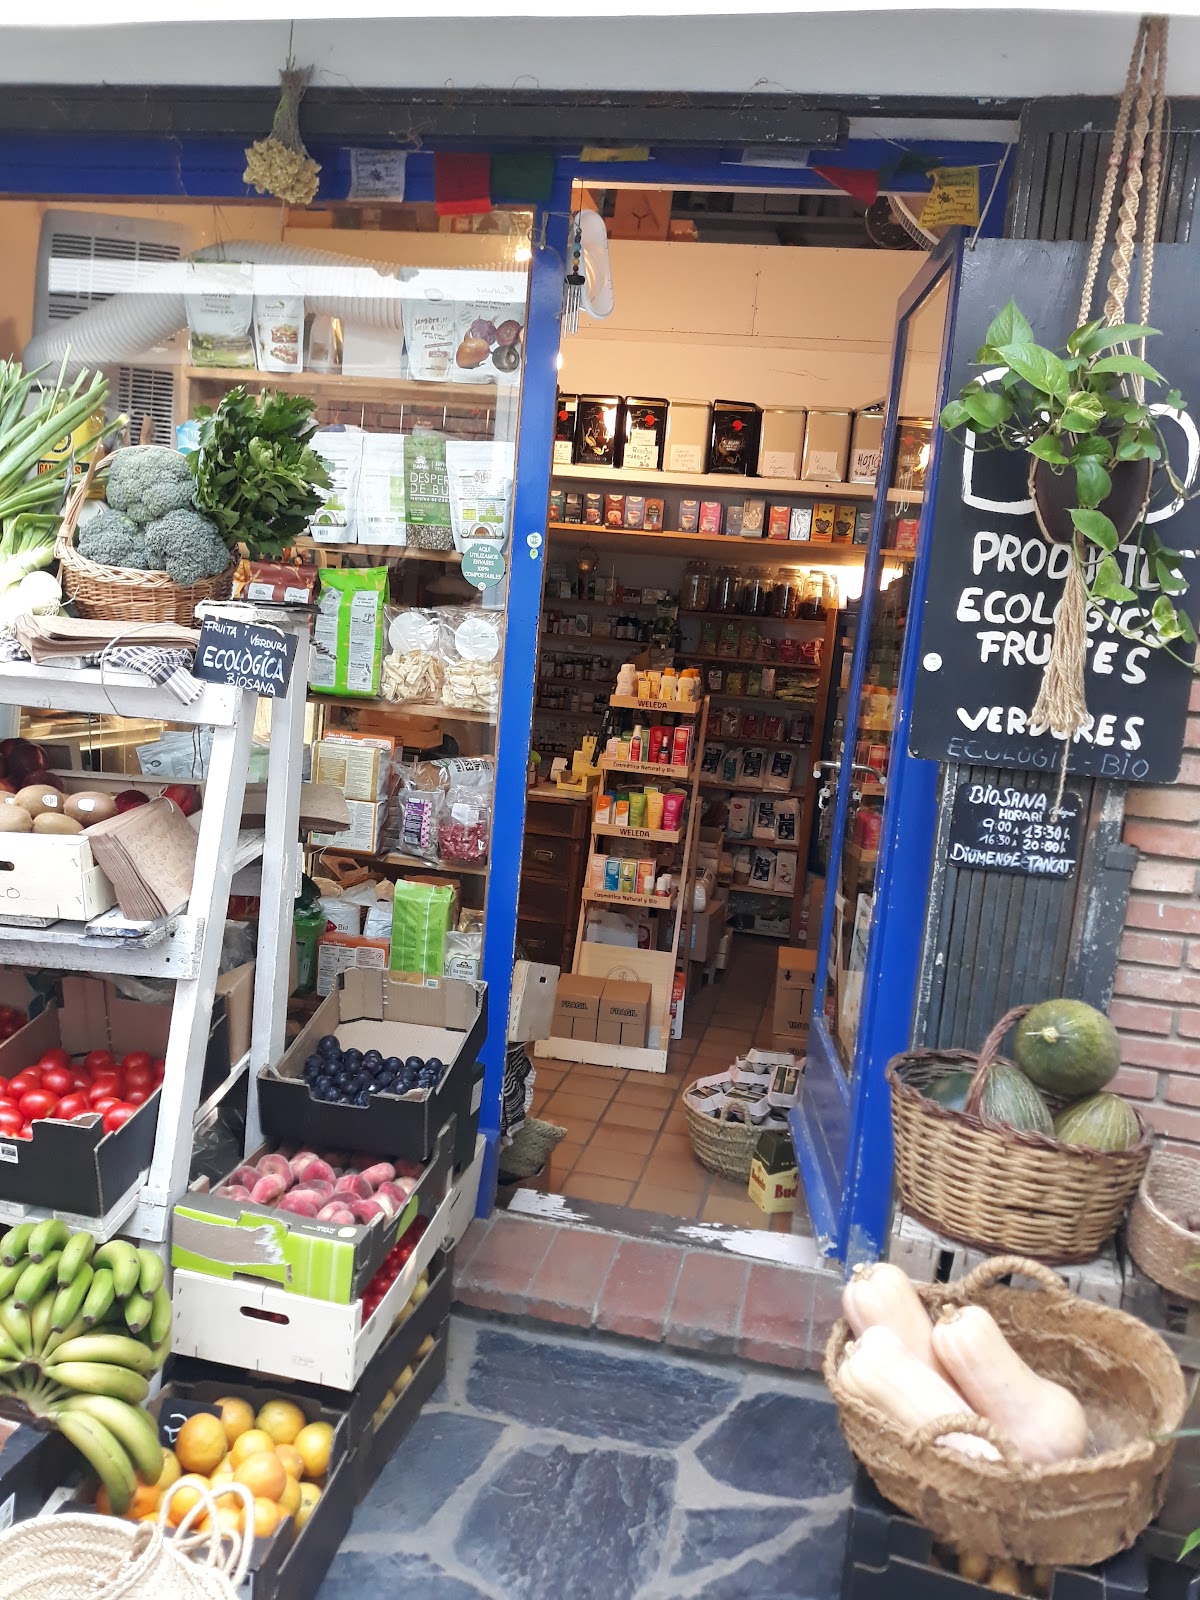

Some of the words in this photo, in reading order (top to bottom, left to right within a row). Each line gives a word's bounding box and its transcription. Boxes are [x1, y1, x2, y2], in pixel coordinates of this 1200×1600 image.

[857, 453, 881, 470] HOJIC
[410, 472, 449, 486] DESPER
[410, 483, 426, 494] DE
[432, 484, 449, 496] BU
[469, 552, 499, 560] UTILIZAMOS
[973, 531, 1192, 597] PRODT
[463, 571, 502, 580] COMPOSTABLES
[956, 587, 1180, 647] ECOLGIC
[203, 619, 238, 639] FRUITA
[249, 633, 288, 657] VERDURA
[202, 645, 285, 684] ECOLÒGICA
[976, 630, 1151, 685] FRUES
[223, 672, 276, 696] BIOSANA
[637, 699, 668, 709] WELEDA
[613, 761, 640, 770] Cosmética
[640, 764, 661, 772] Natural
[1100, 752, 1149, 778] BIO
[968, 784, 1047, 811] BIOSANA
[998, 808, 1044, 823] HORARI
[619, 828, 650, 838] WELEDA
[982, 818, 1012, 833] 9:00
[978, 834, 1010, 846] 16:30
[949, 842, 1022, 868] DIUMENGE
[594, 891, 621, 900] Cosmética
[622, 895, 643, 903] Natural
[561, 1000, 589, 1010] FRAGIL
[609, 1007, 638, 1018] FRAGIL
[774, 1183, 798, 1199] Bud
